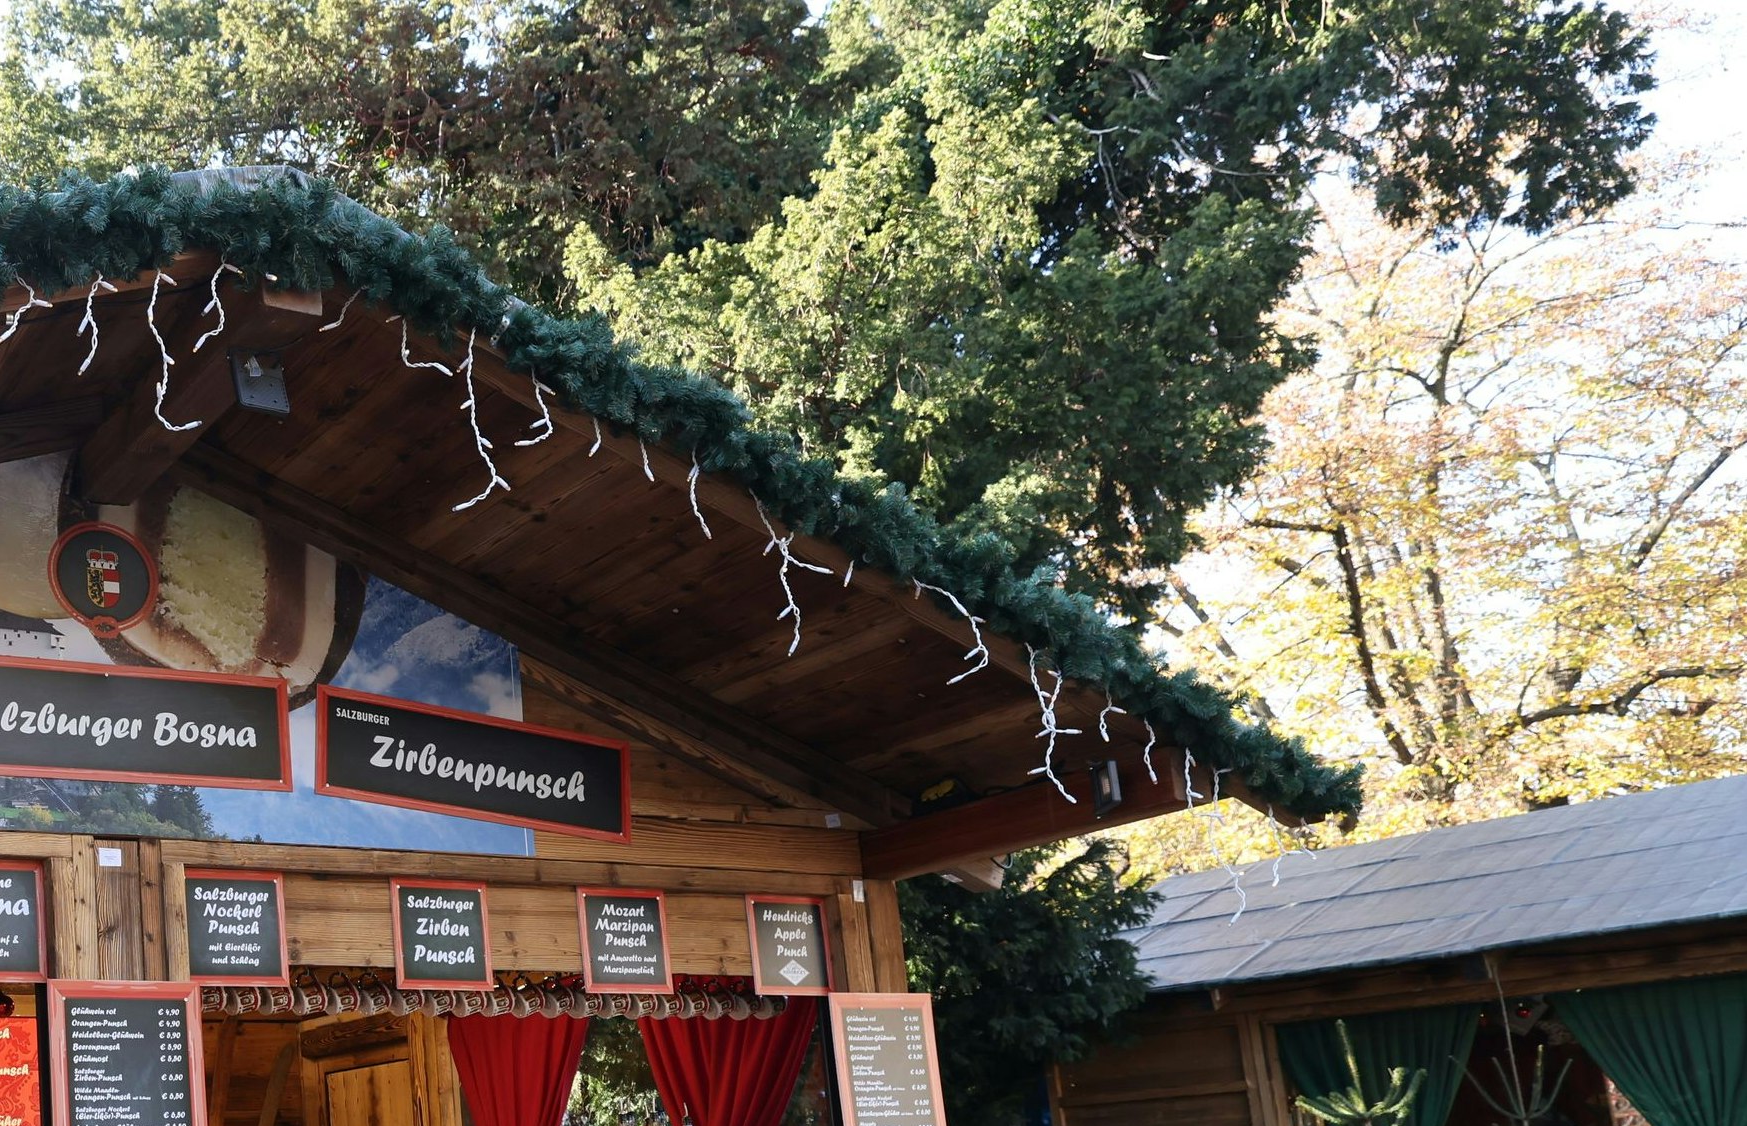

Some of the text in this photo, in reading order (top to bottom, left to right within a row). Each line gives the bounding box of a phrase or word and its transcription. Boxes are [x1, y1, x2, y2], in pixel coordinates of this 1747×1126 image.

[336, 707, 390, 725] SALZBURGER
[153, 712, 257, 748] Bosna
[367, 735, 585, 803] Zirbenpunsch
[194, 887, 269, 904] Salzburger
[203, 903, 262, 919] Nockerl
[407, 895, 474, 912] Salzburger
[601, 904, 644, 917] Mozart
[763, 910, 813, 925] Hendricks
[208, 920, 259, 936] Punsch
[416, 918, 469, 937] Zirben
[595, 918, 654, 934] Marzipan
[12, 935, 19, 944] &
[605, 933, 647, 948] Punsch
[774, 927, 806, 942] Apple
[209, 943, 261, 953] mit Eierlikör
[414, 945, 475, 965] Punsch
[777, 945, 808, 957] Punch
[212, 955, 259, 967] und Schlag
[598, 954, 609, 962] mit
[610, 954, 642, 962] Amaretto
[603, 965, 654, 975] Marzipanstück
[71, 1007, 105, 1016] Glühwein
[71, 1019, 127, 1028] Orangen-Punsch
[72, 1043, 120, 1052] Beerenpunsch
[73, 1054, 108, 1064] Glühmost
